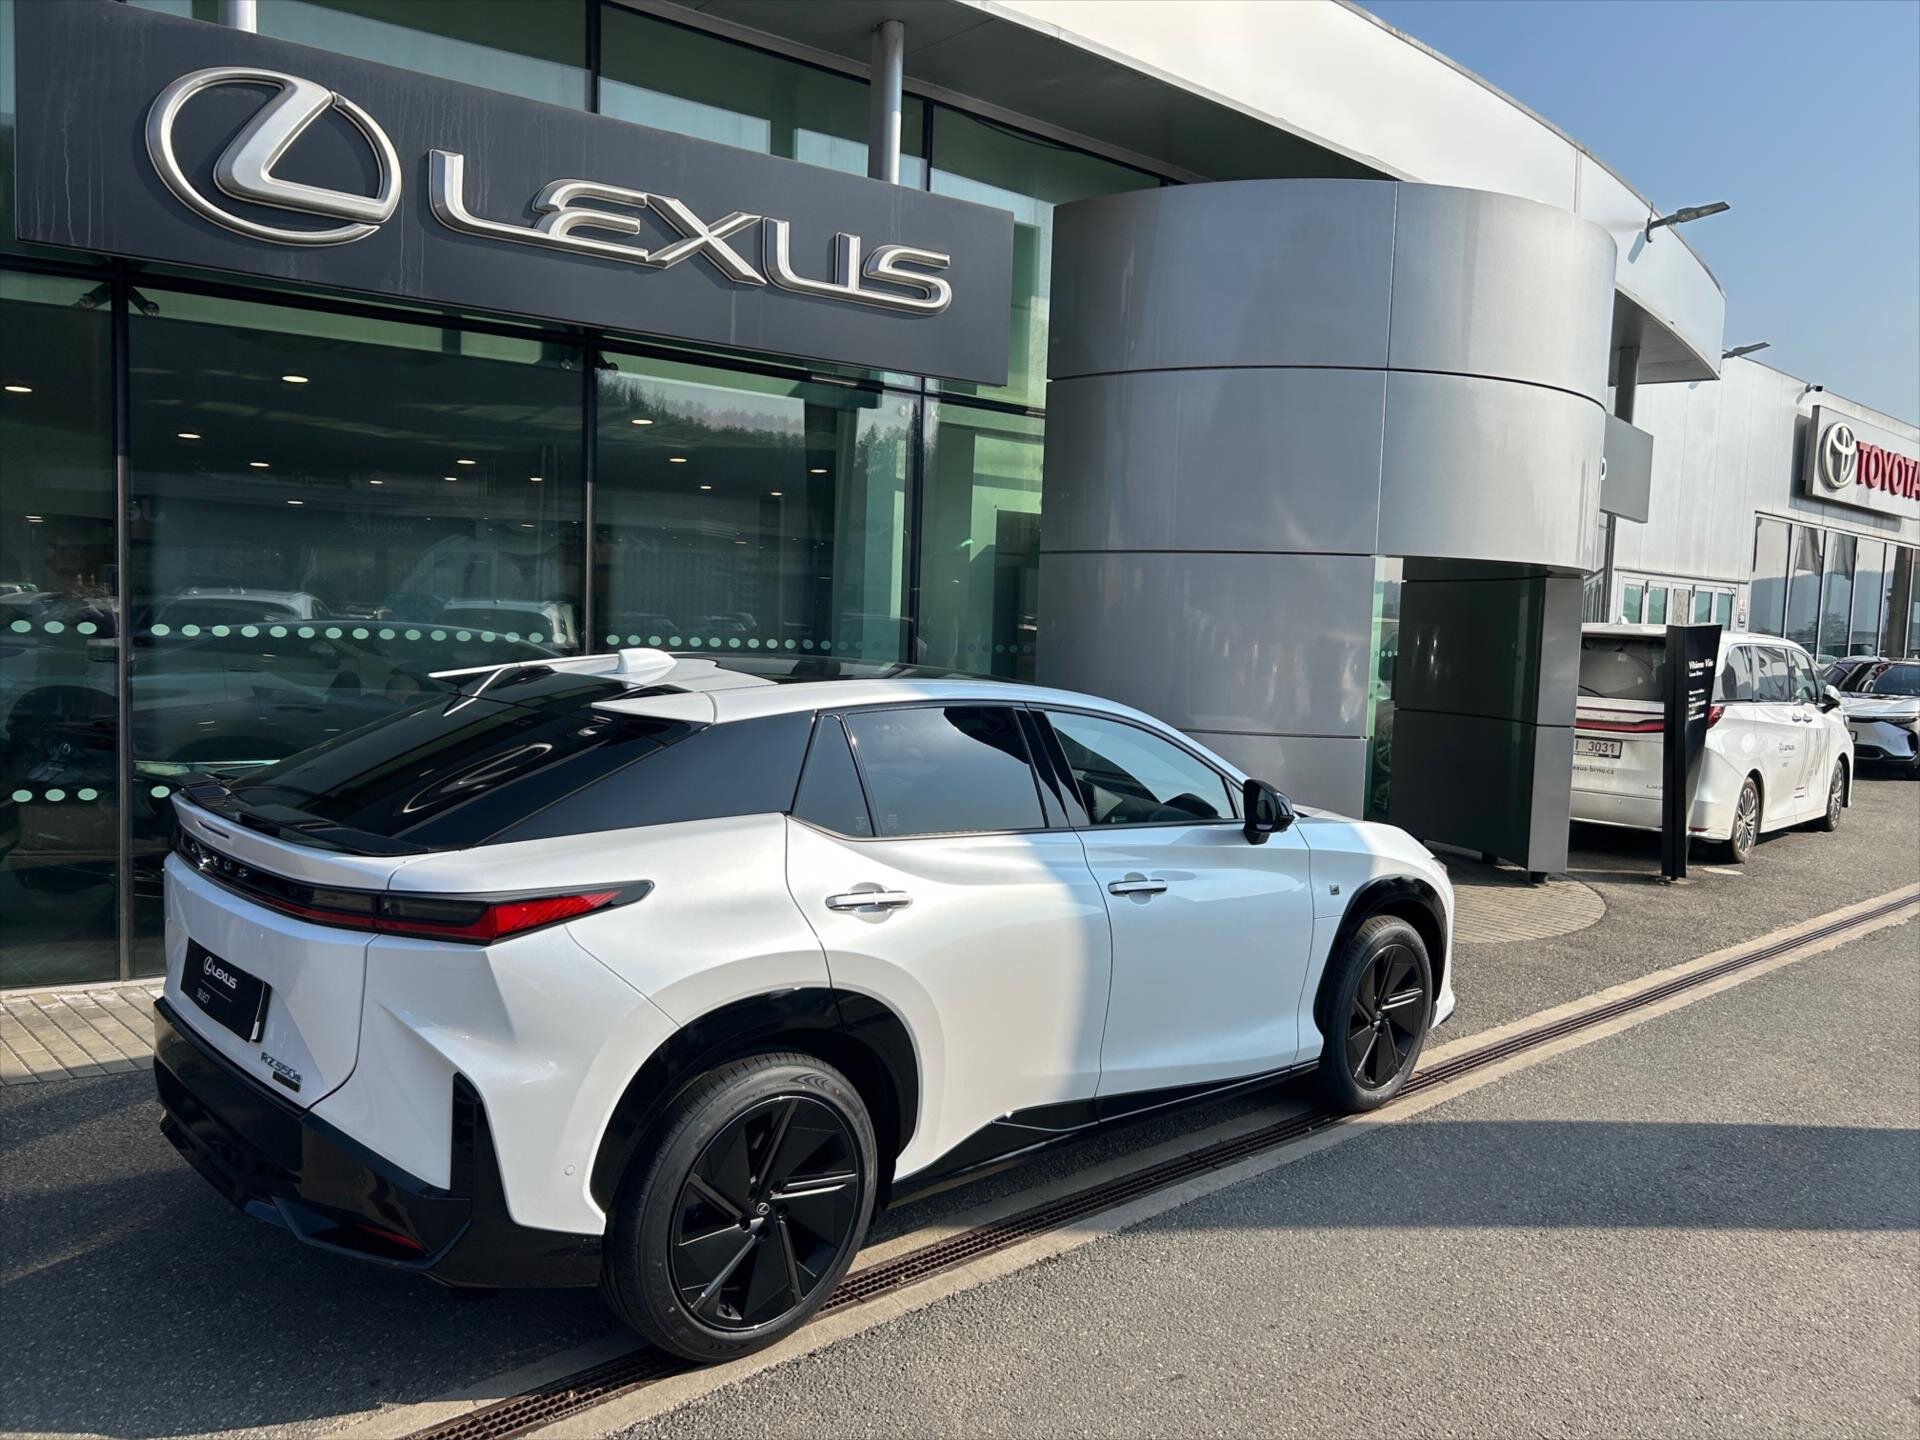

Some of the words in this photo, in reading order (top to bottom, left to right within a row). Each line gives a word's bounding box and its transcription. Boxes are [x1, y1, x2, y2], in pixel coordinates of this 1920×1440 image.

[429, 148, 952, 316] LEXUS
[1588, 741, 1615, 753] 3031
[1573, 765, 1614, 775] exus-brno.cz
[212, 964, 237, 989] LEXUS
